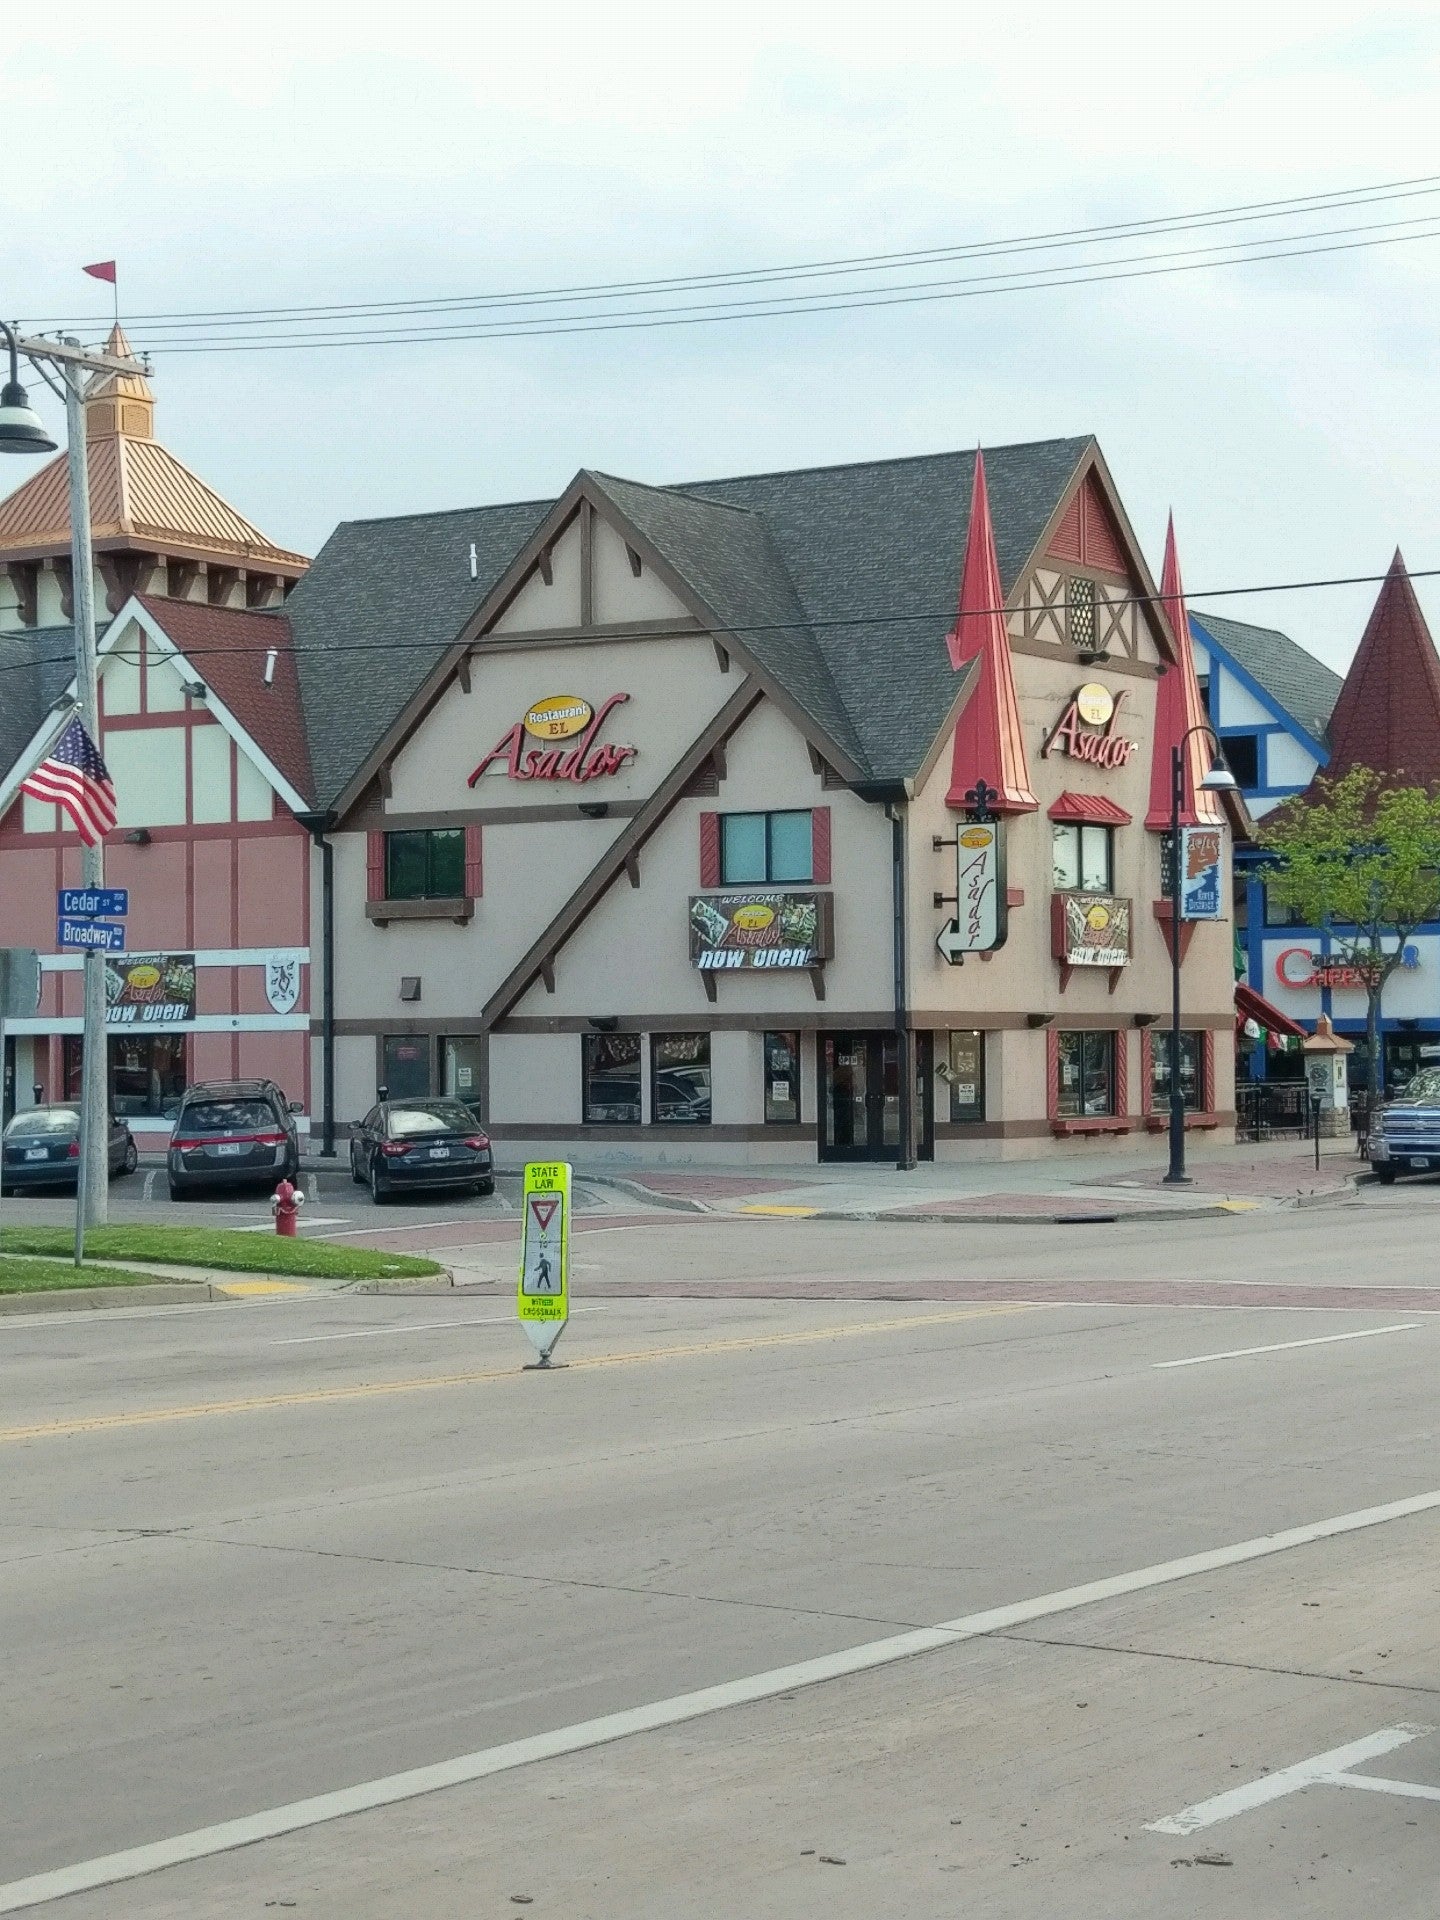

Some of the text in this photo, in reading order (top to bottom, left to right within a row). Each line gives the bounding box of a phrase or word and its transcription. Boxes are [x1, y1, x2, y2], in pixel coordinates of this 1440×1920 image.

[528, 703, 587, 723] Restaurant
[549, 722, 569, 735] EL
[1043, 689, 1137, 769] Asador
[467, 692, 638, 788] Asador
[64, 892, 99, 911] Cedar
[721, 895, 785, 904] WELCOME
[961, 851, 994, 947] Asador
[63, 922, 113, 949] Broadway
[531, 1167, 559, 1178] STATE
[534, 1179, 554, 1190] LAW
